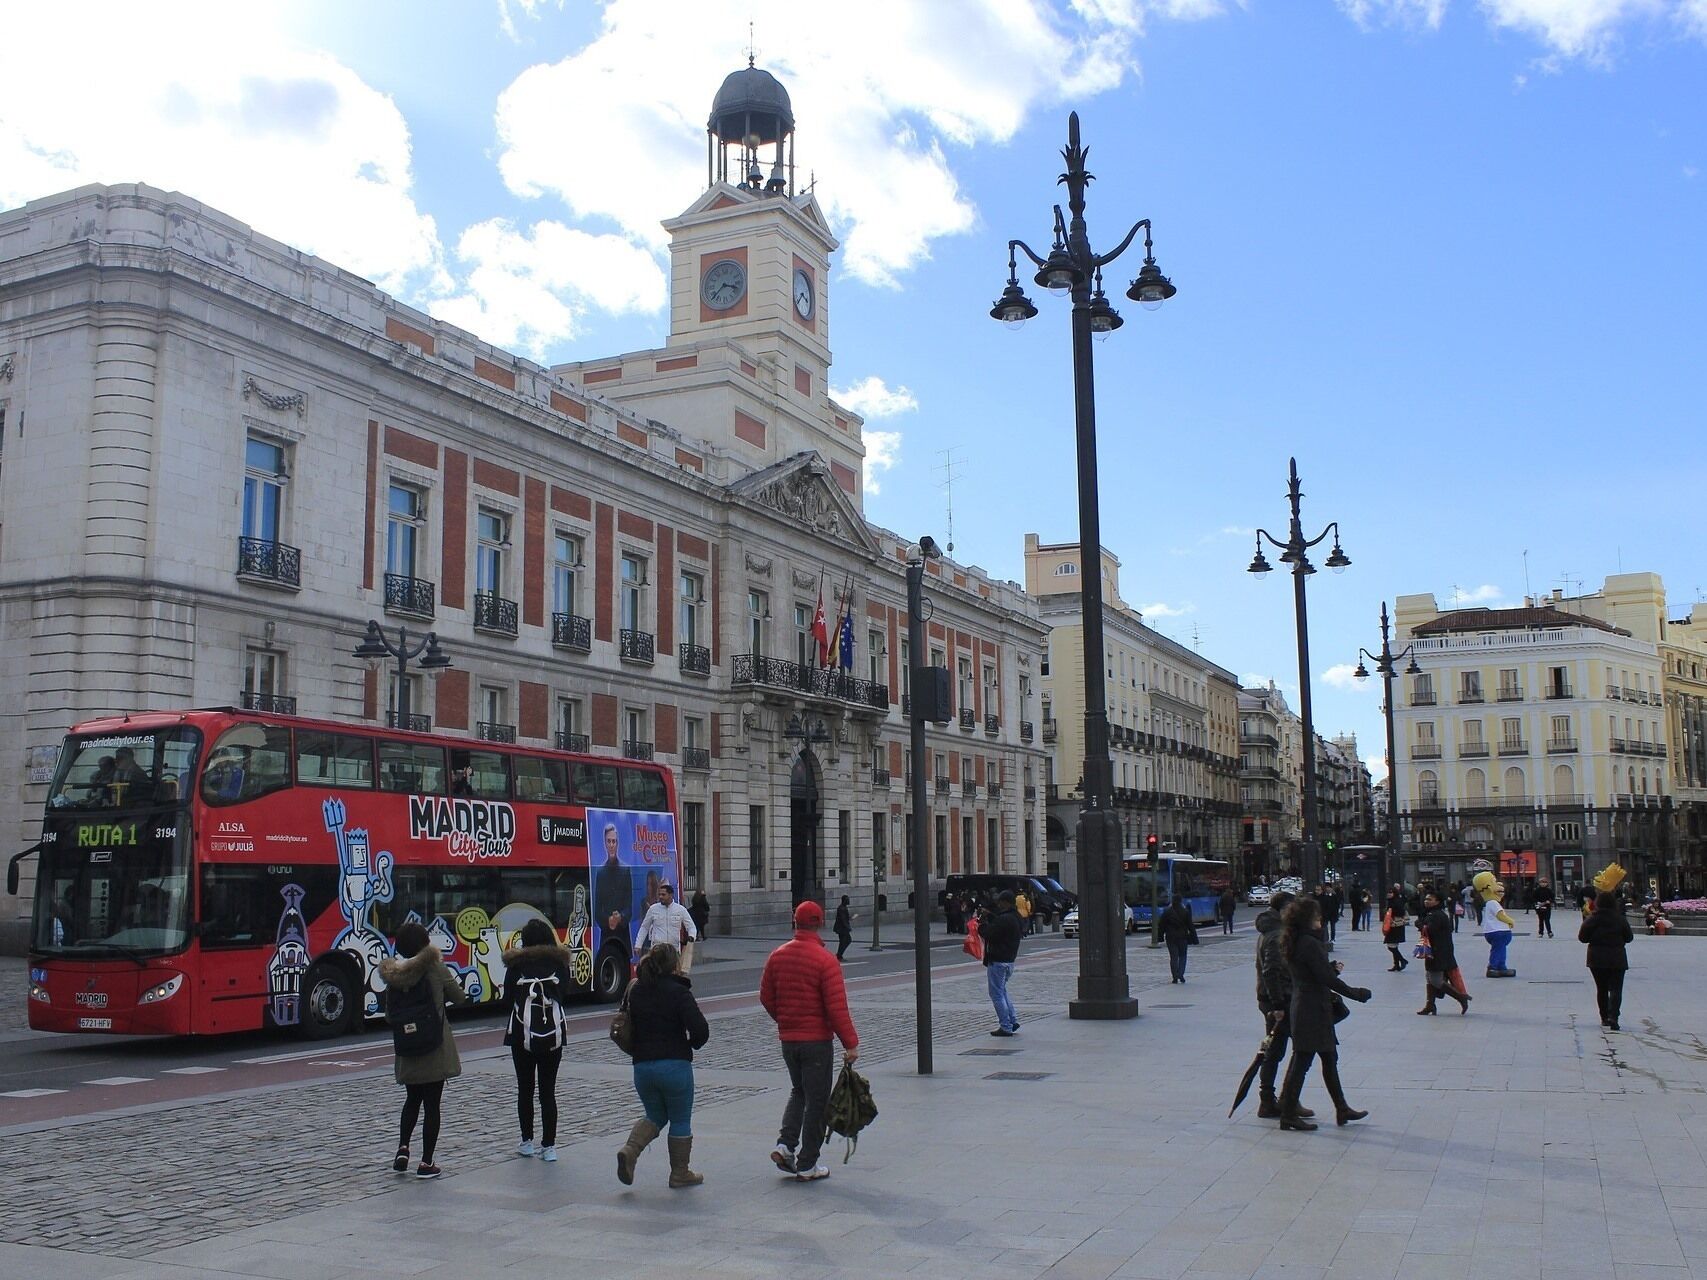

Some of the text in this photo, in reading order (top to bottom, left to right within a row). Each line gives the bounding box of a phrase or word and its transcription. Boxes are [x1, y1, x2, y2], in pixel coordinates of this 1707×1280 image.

[80, 735, 155, 749] madridcitytour.es
[218, 822, 245, 832] ALSA
[411, 797, 513, 842] MADRID
[42, 832, 57, 843] 3194
[78, 824, 137, 847] RUTA 1
[155, 827, 177, 838] 3194
[636, 824, 668, 842] Museo
[449, 829, 512, 862] City Tour
[632, 842, 643, 852] de
[643, 844, 667, 864] Cera
[75, 993, 108, 1005] MADRID
